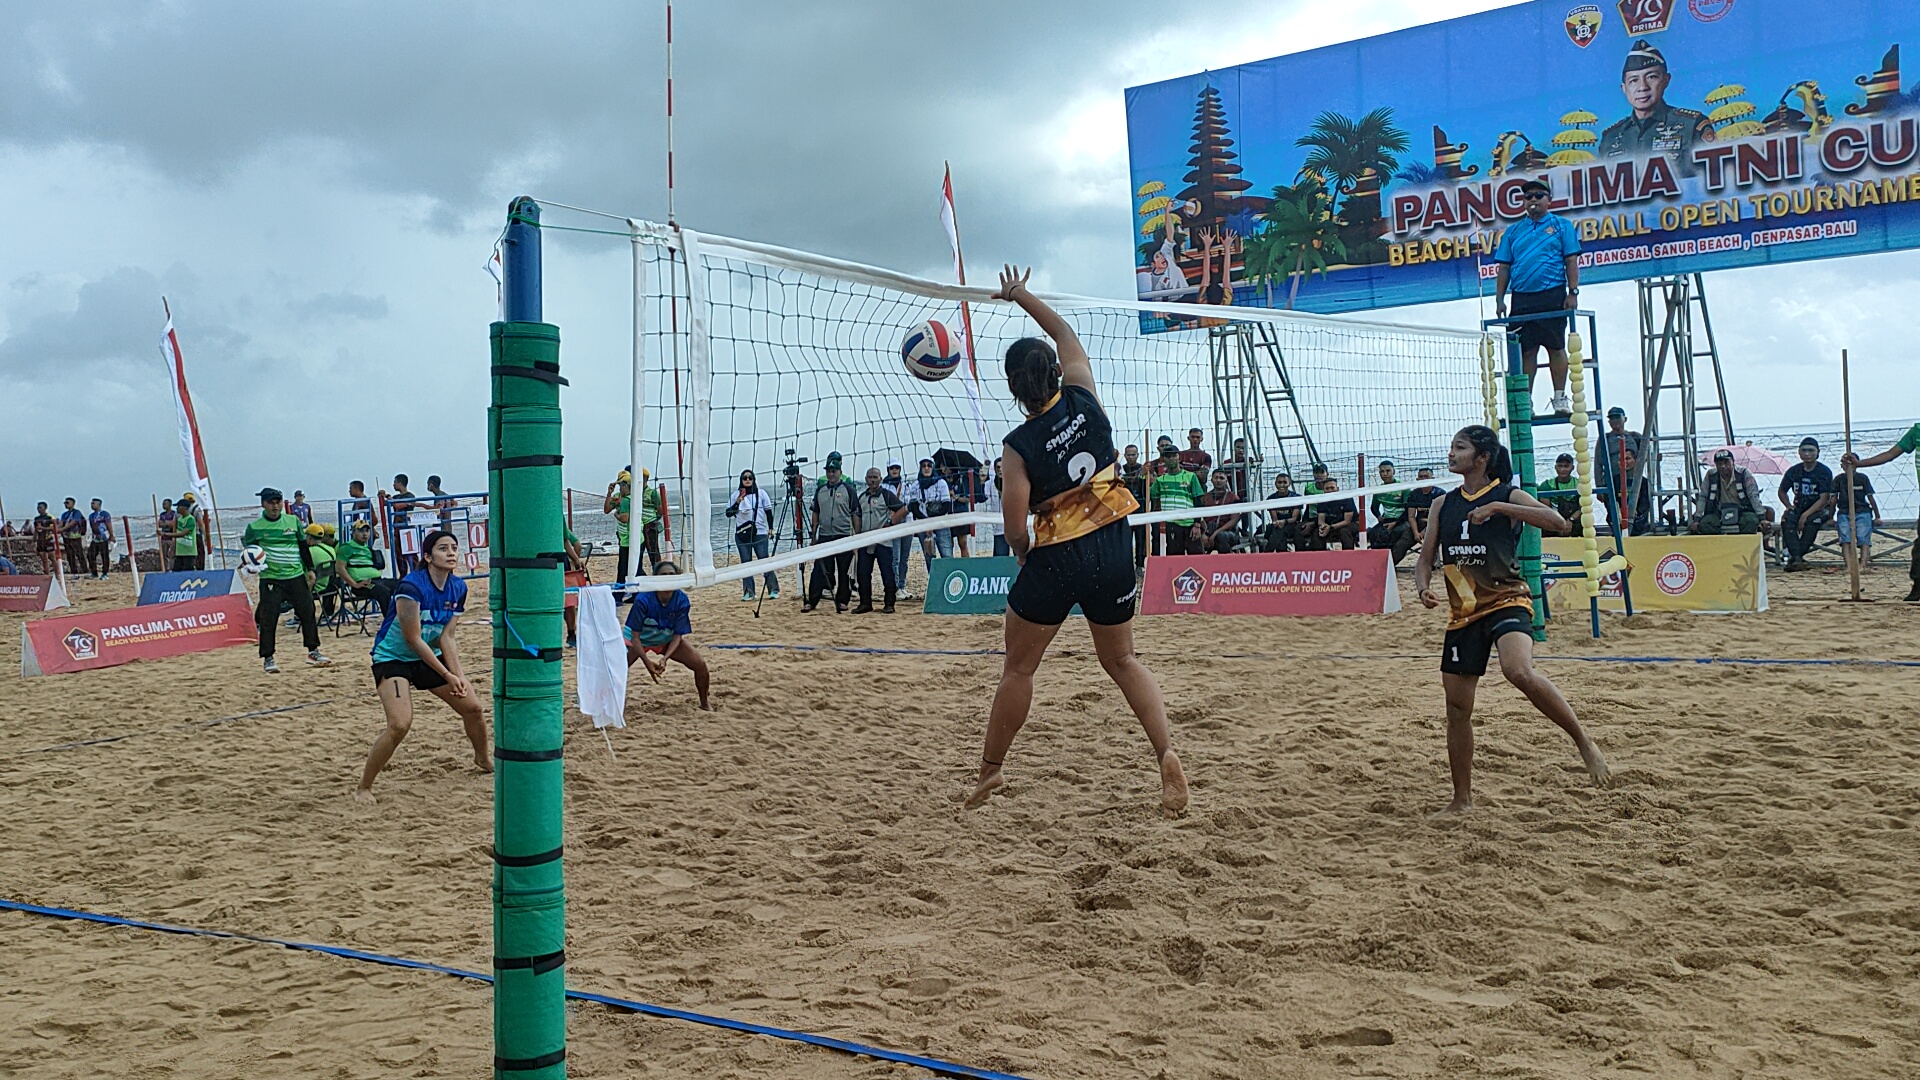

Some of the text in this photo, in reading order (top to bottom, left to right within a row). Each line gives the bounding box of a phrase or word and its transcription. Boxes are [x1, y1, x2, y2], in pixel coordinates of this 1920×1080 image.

[1632, 21, 1664, 33] PRIMA
[1693, 134, 1803, 190] TNI
[1389, 234, 1470, 266] BEACH
[1660, 198, 1740, 231] OPEN
[1596, 246, 1650, 264] BANGSAL
[1654, 241, 1694, 257] SANUR
[1700, 235, 1740, 251] BEACH
[1753, 221, 1857, 245] DENPASAR-BALI
[470, 524, 486, 547] 0
[1461, 519, 1470, 540] 1
[403, 530, 414, 552] 1
[467, 553, 477, 568] 0
[968, 576, 1011, 595] BANK
[1212, 569, 1352, 586] PANGLIMA TNI CUP
[1211, 584, 1350, 594] BEACH VOLLEYBALL OPEN TOURNAMENT
[1600, 589, 1621, 597] RIMA
[101, 611, 226, 639] PANGLIMA TNI CUP
[105, 624, 229, 647] BEACH VOLLEYBALL OPEN TOURNAMENT
[1451, 646, 1460, 662] 1
[393, 679, 401, 698] 1
